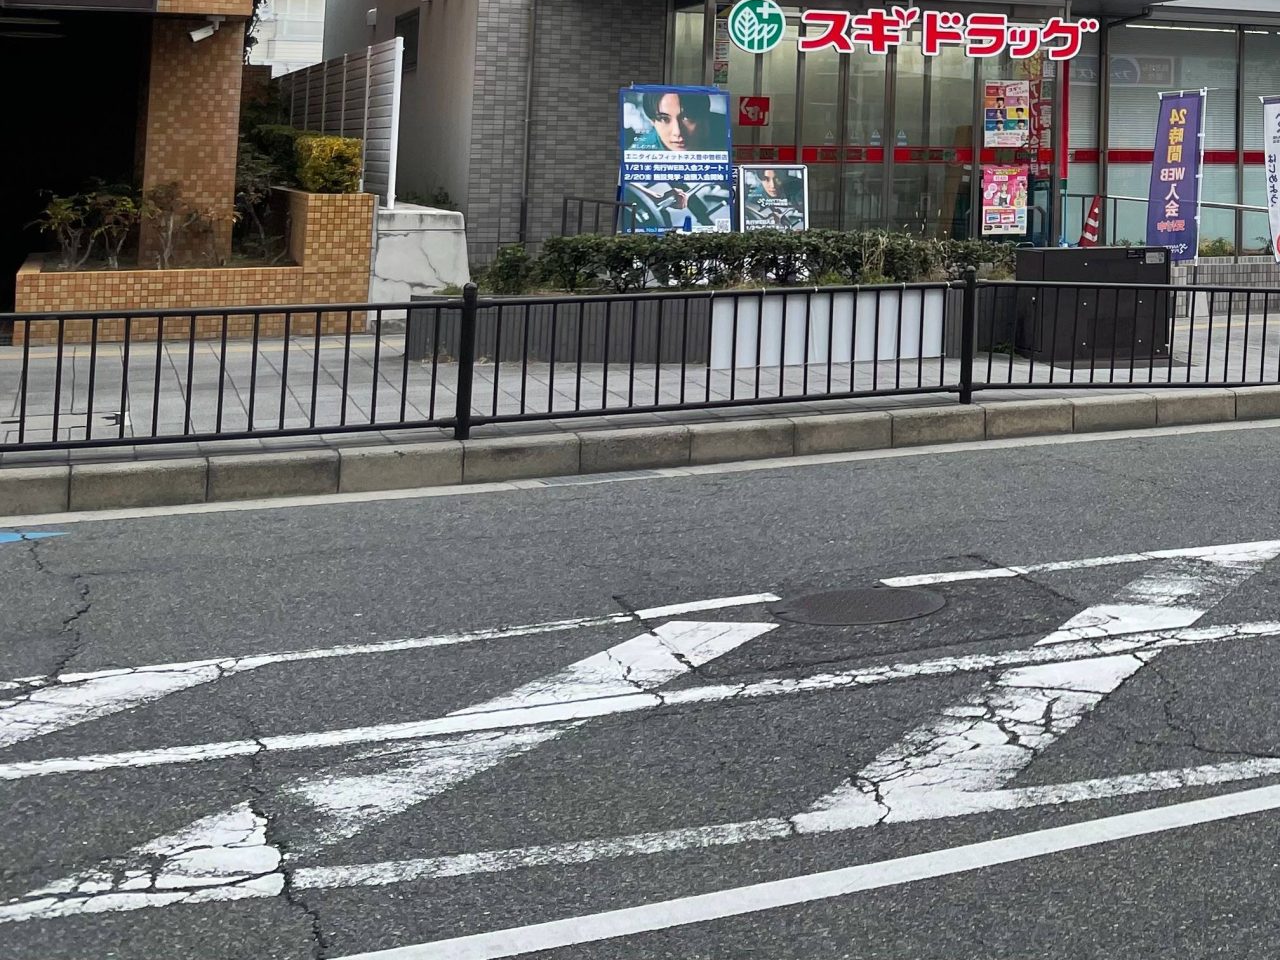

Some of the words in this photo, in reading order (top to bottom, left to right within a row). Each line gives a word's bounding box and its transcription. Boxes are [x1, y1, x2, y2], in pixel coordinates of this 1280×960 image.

[799, 5, 1099, 61] スギドラッグ
